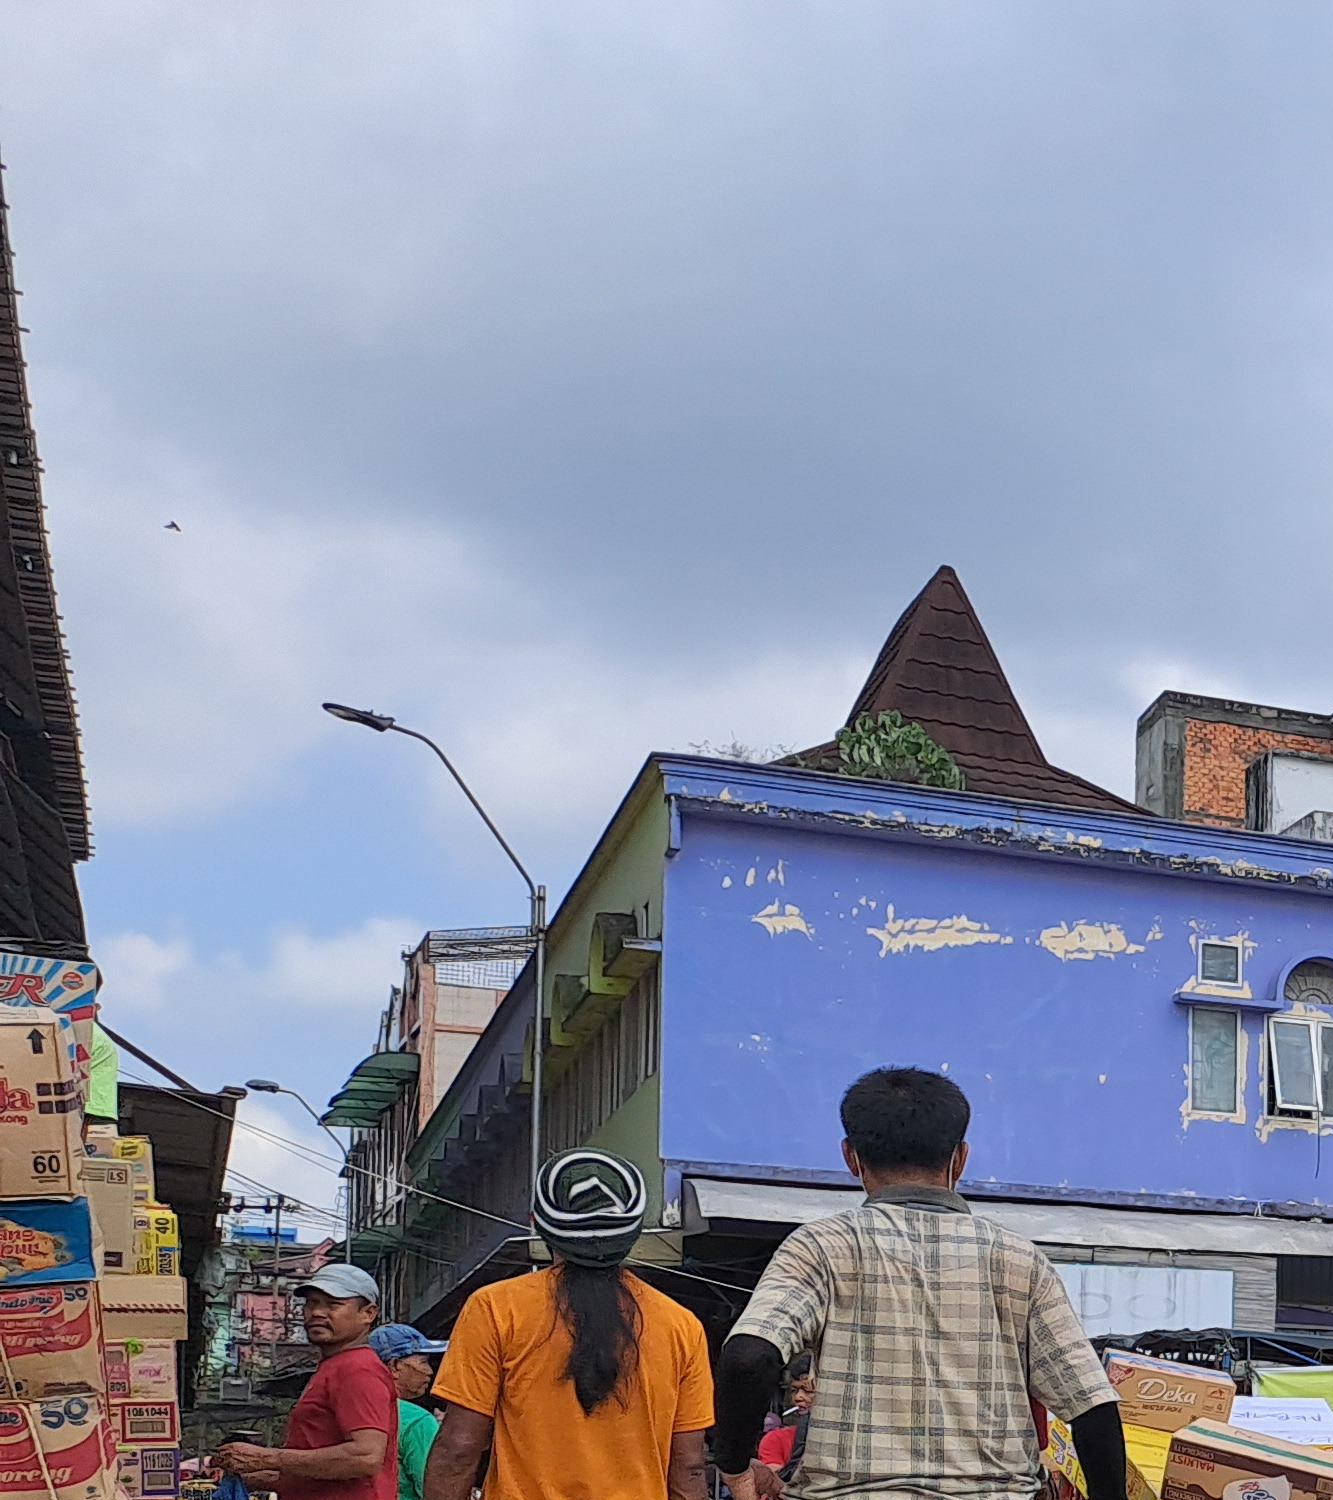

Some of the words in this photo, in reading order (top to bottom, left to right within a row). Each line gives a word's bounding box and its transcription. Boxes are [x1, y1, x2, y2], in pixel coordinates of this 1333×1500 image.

[33, 1155, 61, 1174] 60
[63, 1287, 88, 1302] 50
[1137, 1378, 1197, 1405] Deka
[41, 1398, 89, 1429] 50
